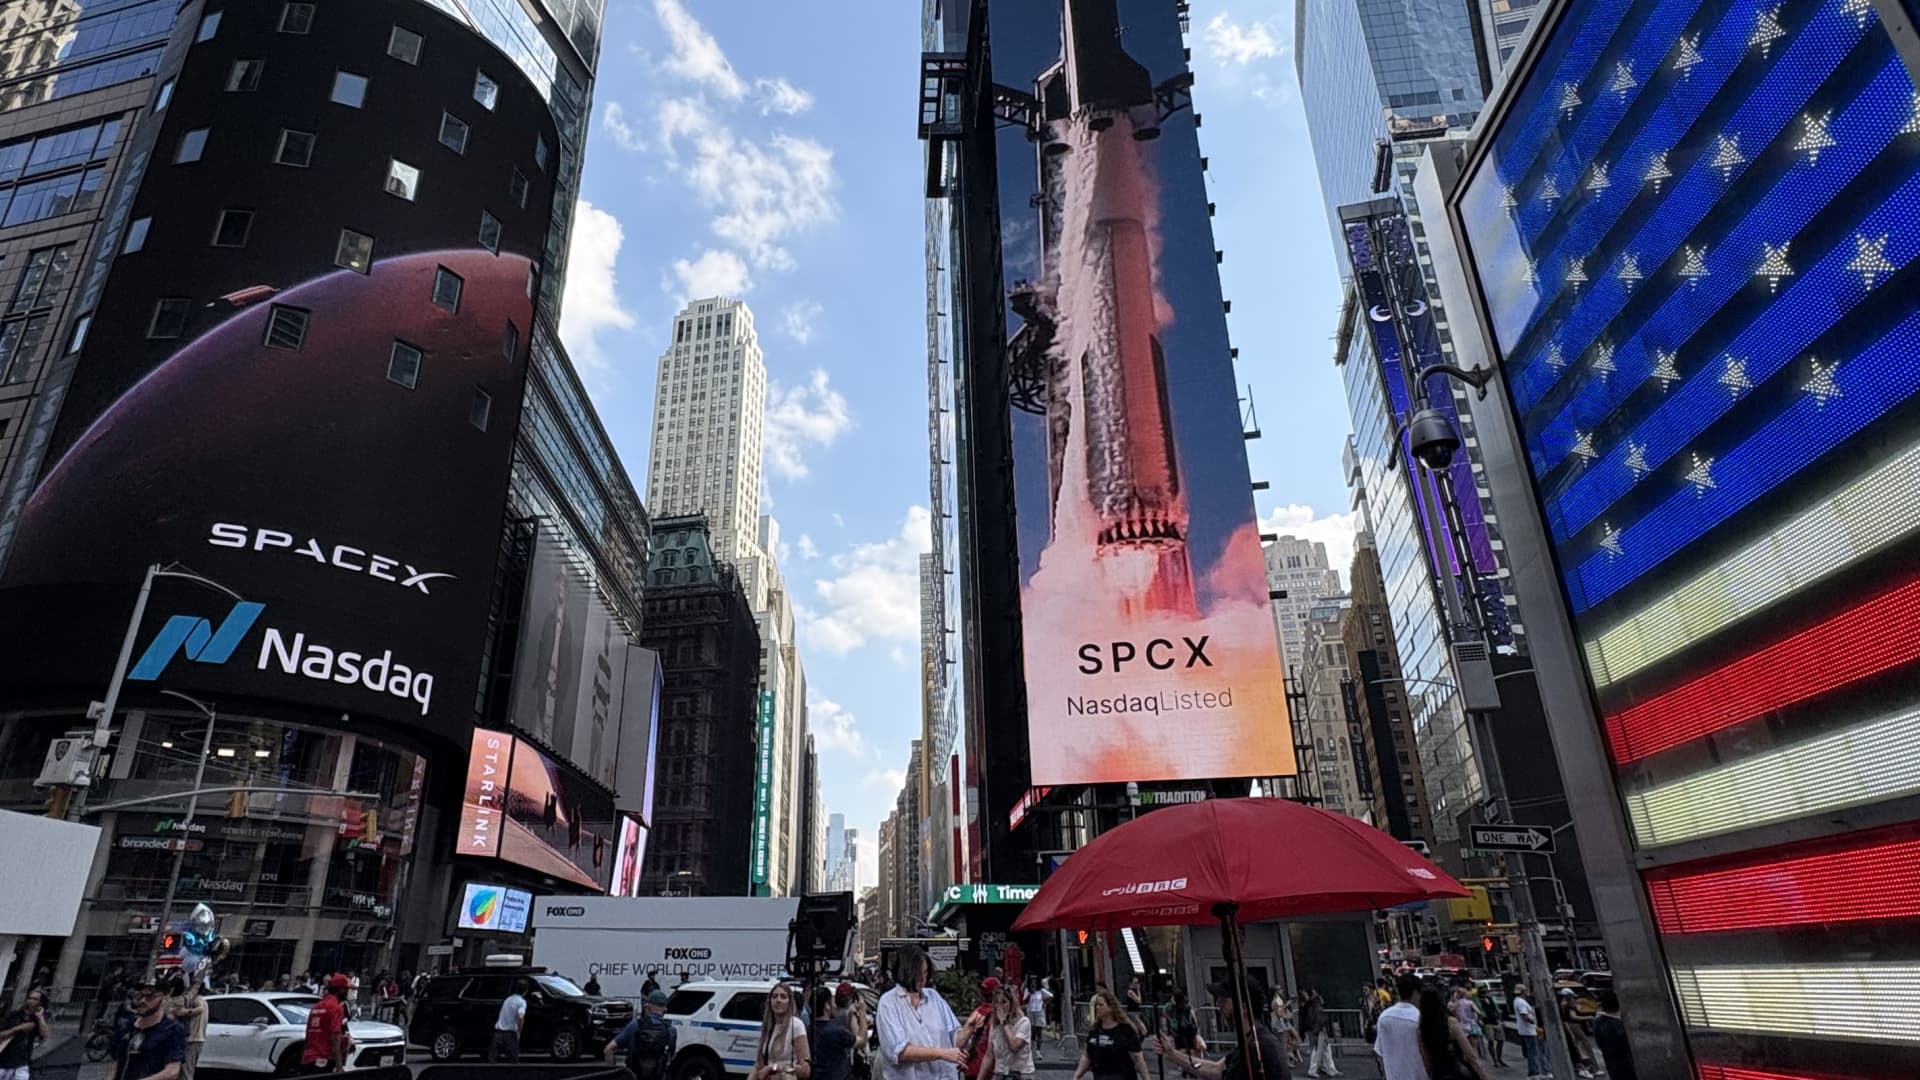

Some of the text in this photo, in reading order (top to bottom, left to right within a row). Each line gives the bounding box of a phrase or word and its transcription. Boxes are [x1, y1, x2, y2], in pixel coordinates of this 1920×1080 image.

[208, 522, 458, 595] SPACEX
[1078, 635, 1213, 675] SPCX
[257, 628, 435, 717] Nasdaq
[472, 738, 500, 848] STARLINK
[1482, 832, 1541, 844] ONE WAY
[199, 878, 244, 892] Nasdaq
[1102, 877, 1188, 896] BBC فارسی
[546, 906, 566, 917] FOX
[665, 948, 712, 960] FOX ONE
[588, 963, 629, 976] CHIEF
[632, 963, 684, 976] WORLD
[687, 963, 716, 976] CUP
